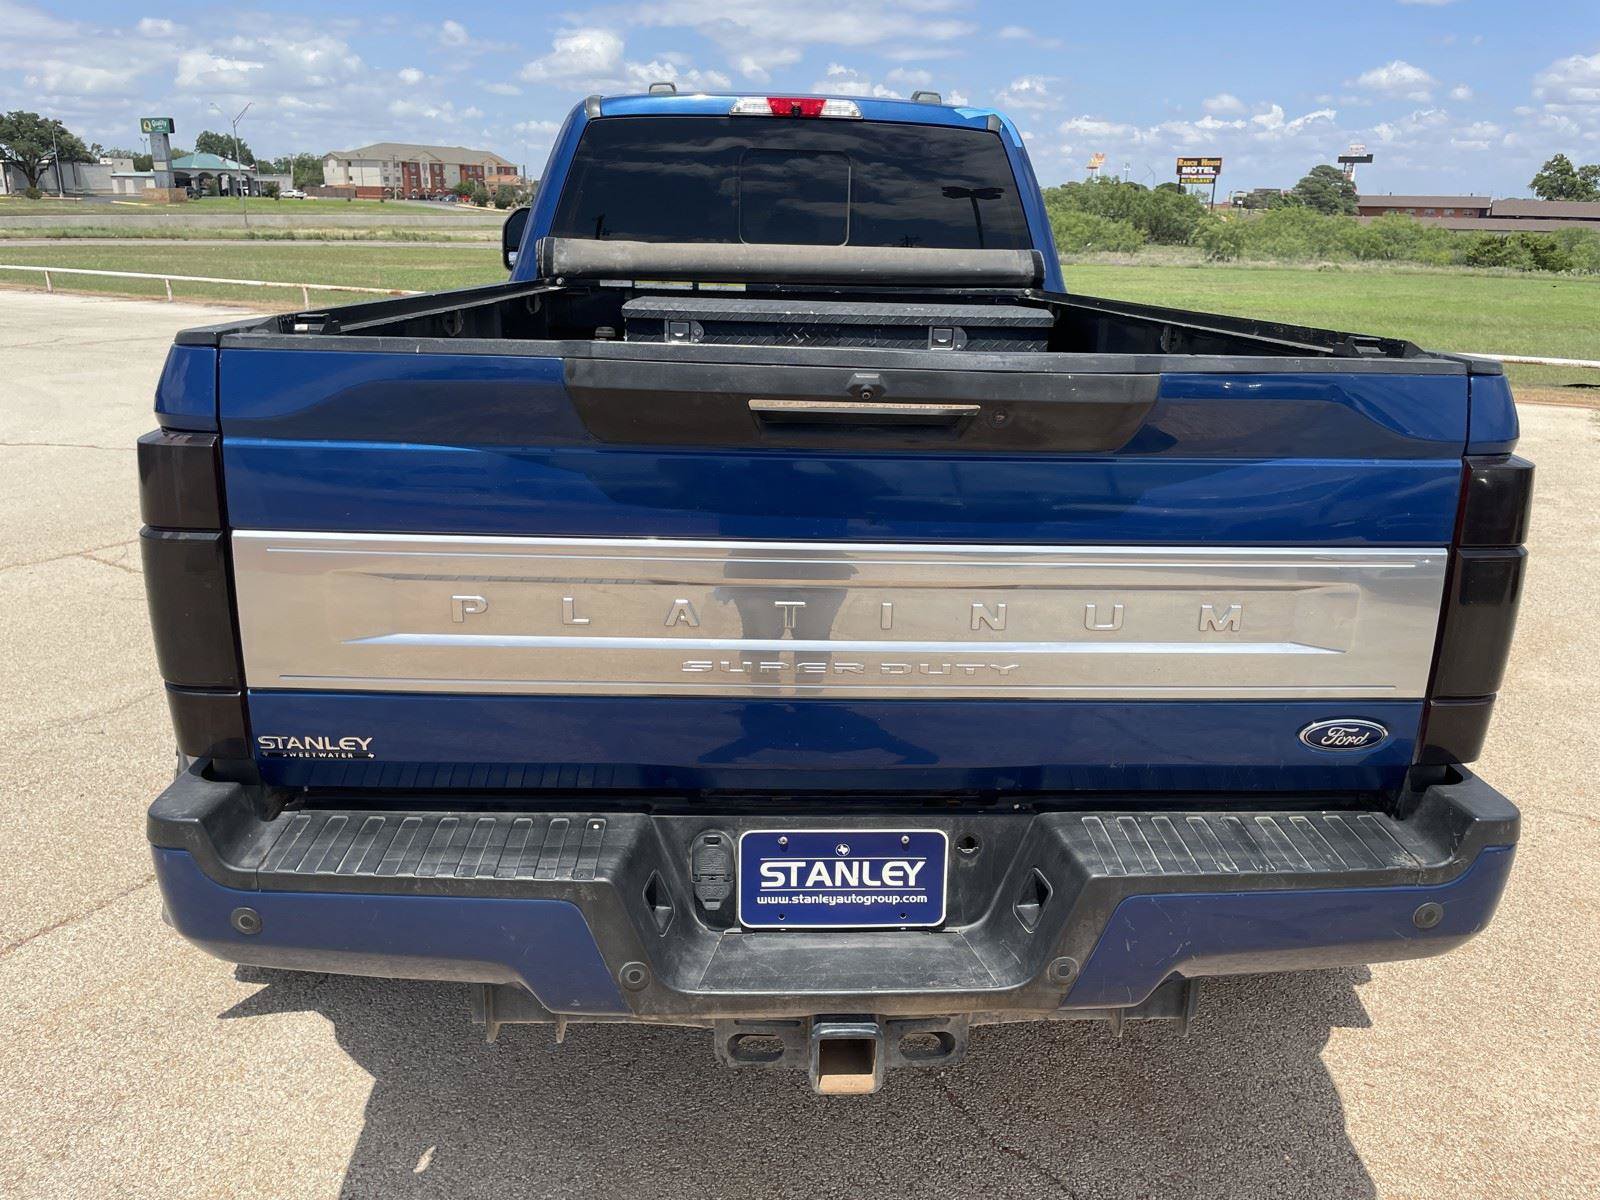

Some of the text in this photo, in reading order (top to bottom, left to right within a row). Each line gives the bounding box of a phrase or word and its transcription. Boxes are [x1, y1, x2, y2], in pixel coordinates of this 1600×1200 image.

[1181, 166, 1216, 174] MOTEL
[451, 594, 1243, 632] PLATINUM
[681, 659, 1020, 676] SUPER DUTY
[257, 735, 374, 751] STANLEY
[1321, 727, 1370, 745] Ford
[282, 751, 354, 759] SWEETWATER
[759, 861, 926, 889] STANLEY
[757, 893, 927, 905] www.stanleyautogroup.com
